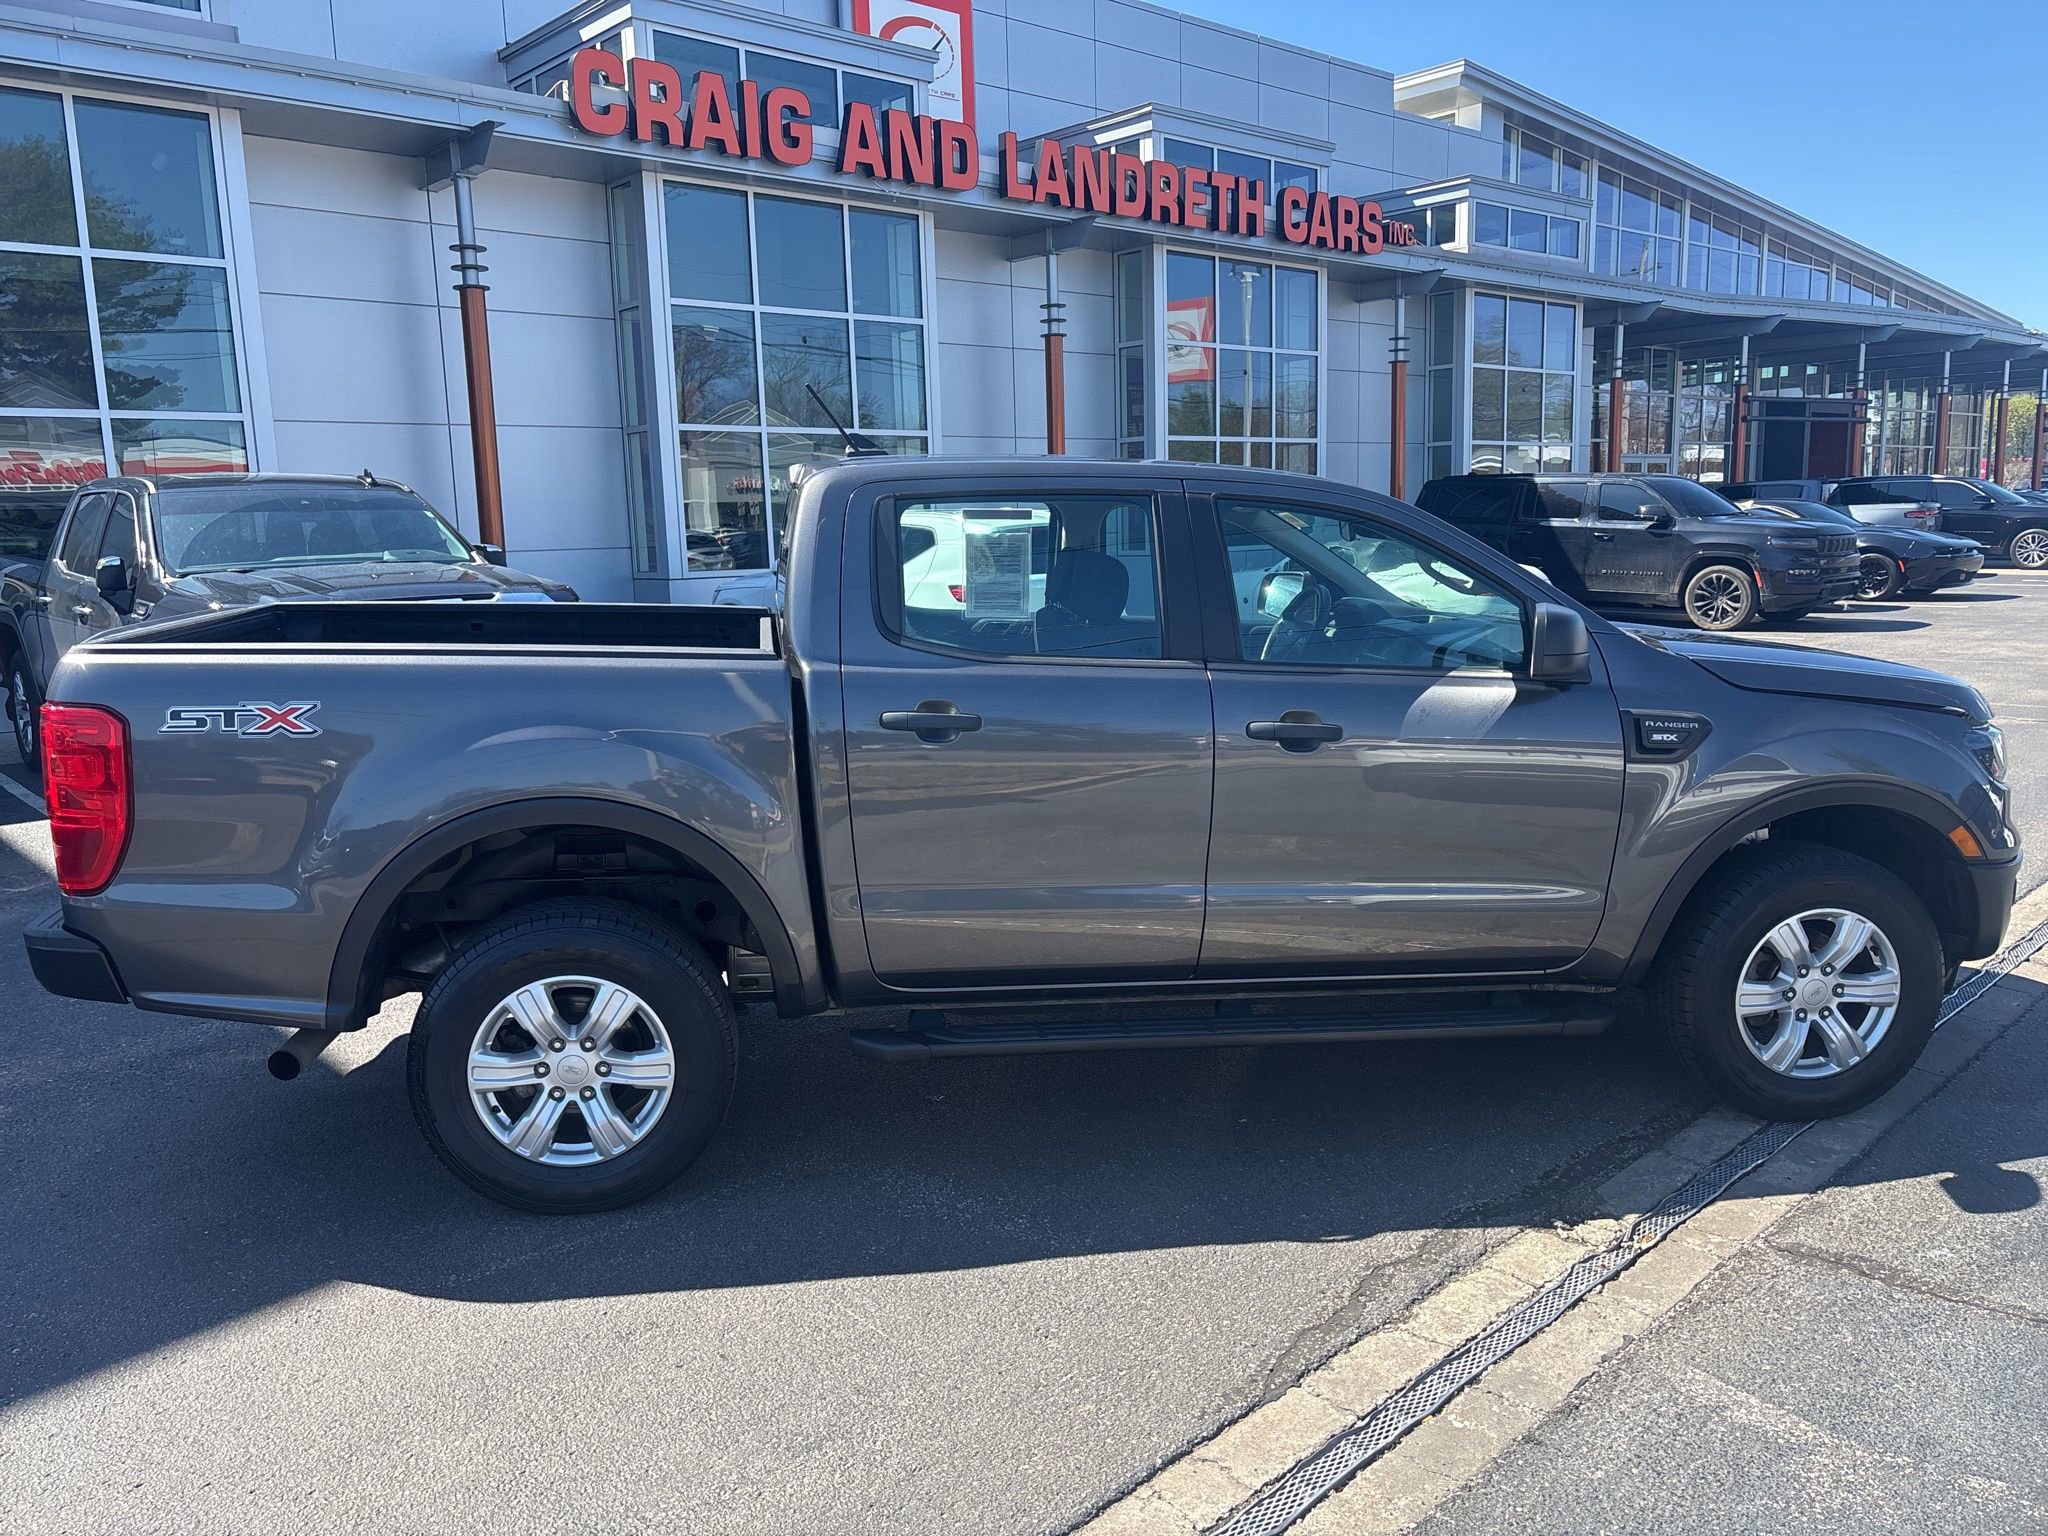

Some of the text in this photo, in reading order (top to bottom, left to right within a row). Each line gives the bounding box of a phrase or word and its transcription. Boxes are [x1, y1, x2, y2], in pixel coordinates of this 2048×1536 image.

[569, 49, 813, 167] CRAIG
[838, 102, 980, 192] AND
[1001, 130, 1266, 238] LANDRETH
[1278, 186, 1384, 255] CARS
[158, 701, 322, 738] STX
[1645, 720, 1699, 729] RANGER
[1651, 733, 1679, 741] STX
